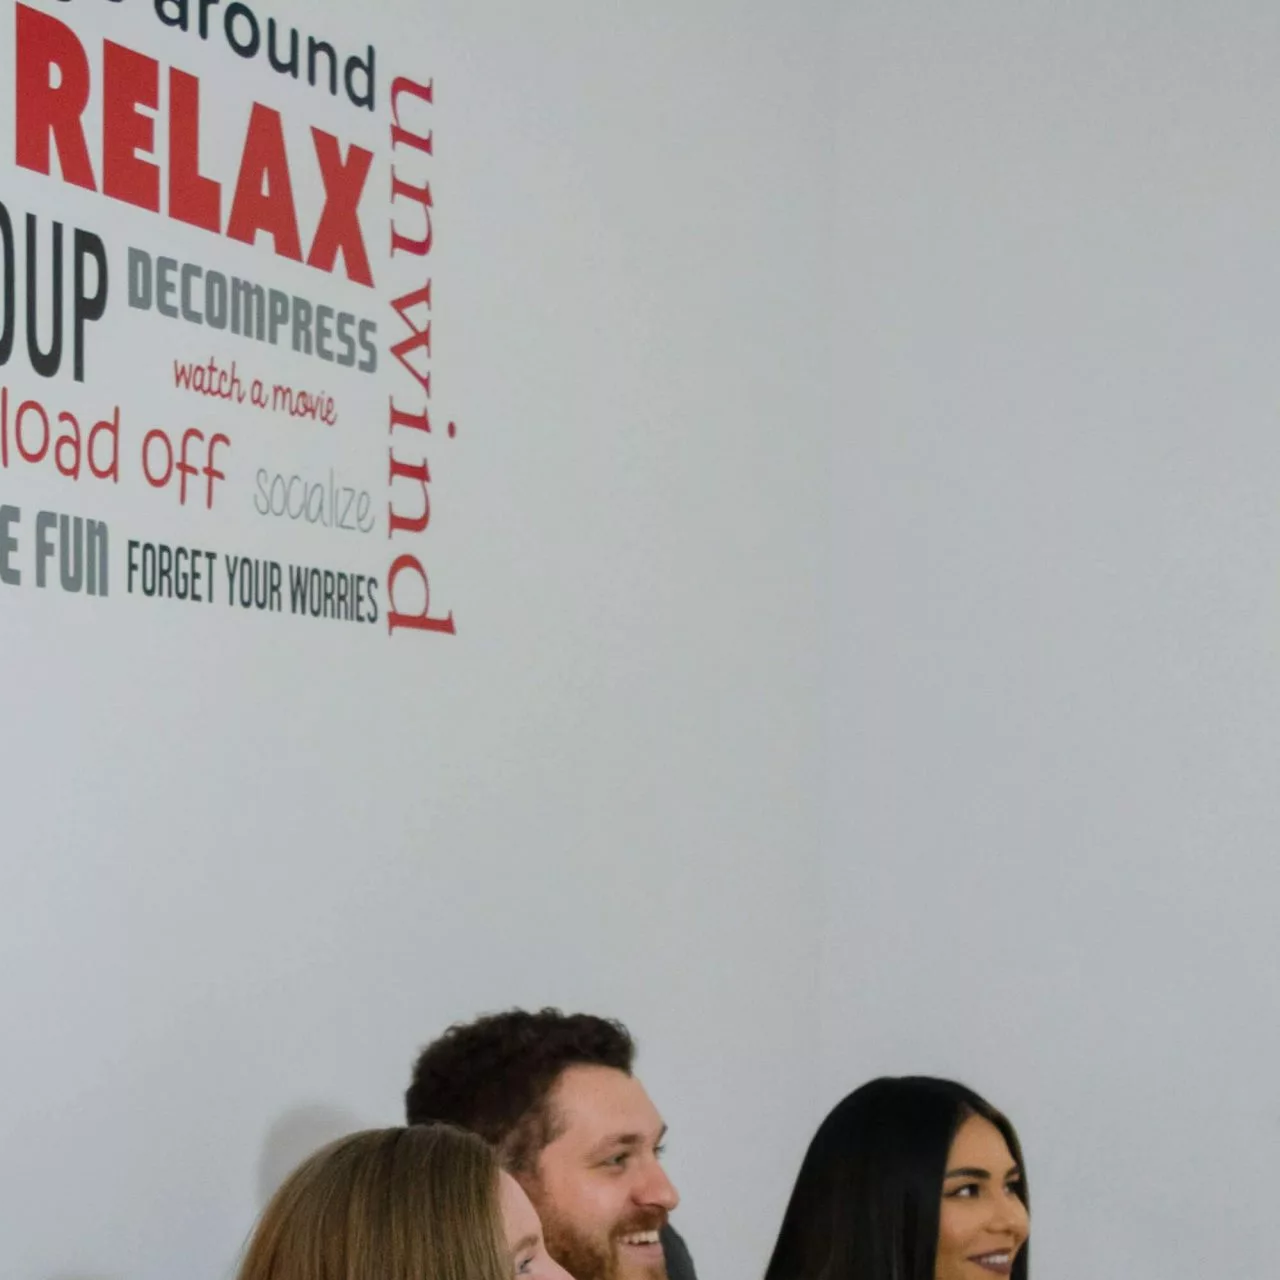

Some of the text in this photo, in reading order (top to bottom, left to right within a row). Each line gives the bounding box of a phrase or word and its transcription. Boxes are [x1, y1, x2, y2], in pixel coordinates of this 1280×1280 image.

[154, 0, 375, 112] around
[15, 1, 375, 288] RELAX
[127, 246, 378, 374] DECOMPRESS
[387, 76, 457, 637] unwind
[1, 386, 120, 484] load
[141, 427, 231, 509] off
[173, 356, 338, 427] watch a movie
[35, 510, 109, 597] FUN
[254, 467, 375, 534] socialize
[127, 539, 379, 624] FORGET YOUR WORRIES
